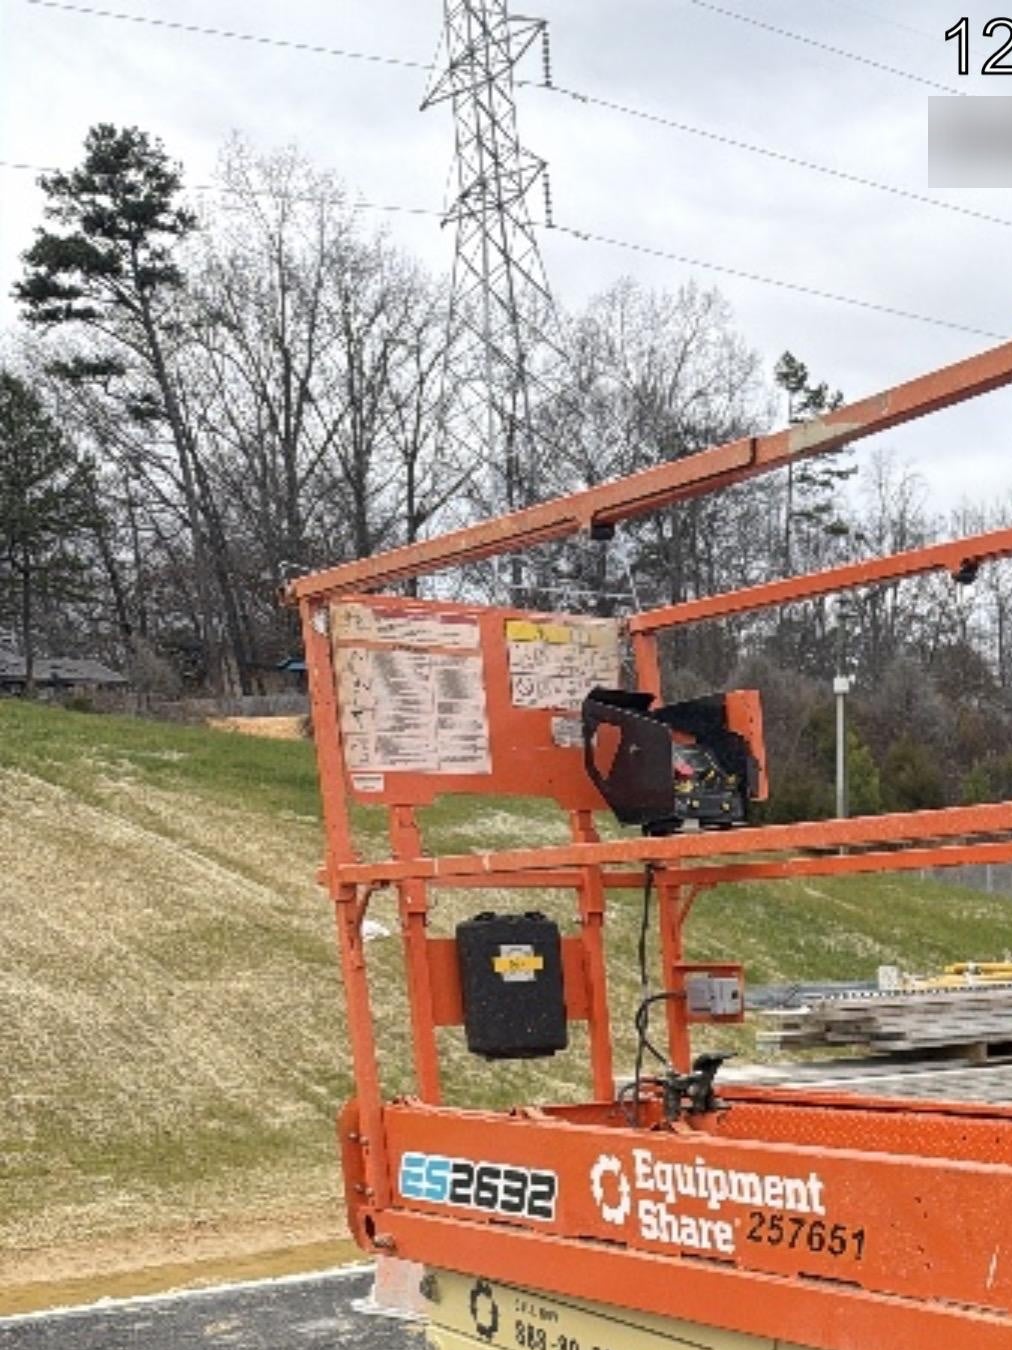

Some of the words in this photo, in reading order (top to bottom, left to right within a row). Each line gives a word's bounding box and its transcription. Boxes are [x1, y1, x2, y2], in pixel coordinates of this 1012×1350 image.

[399, 1151, 559, 1222] ES2632
[632, 1148, 826, 1216] Equipment
[637, 1199, 736, 1254] Share
[746, 1211, 866, 1261] 257651
